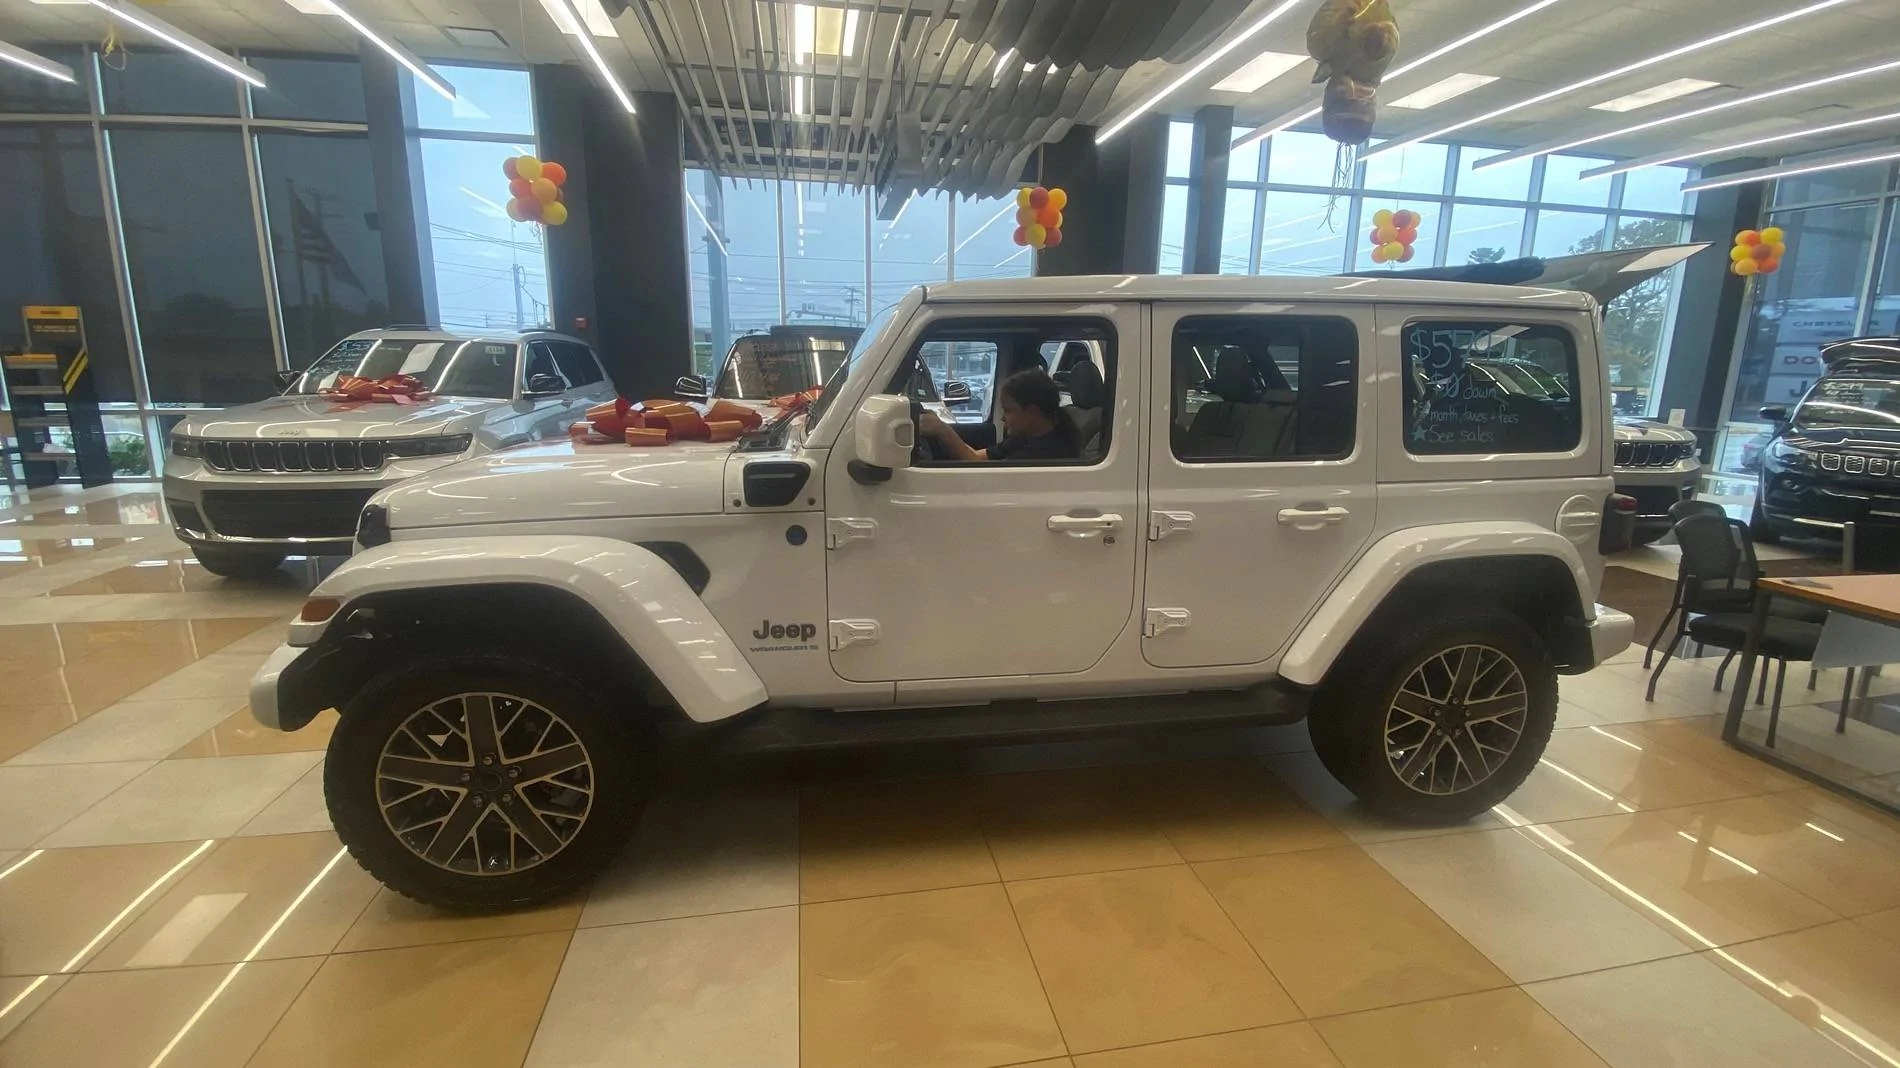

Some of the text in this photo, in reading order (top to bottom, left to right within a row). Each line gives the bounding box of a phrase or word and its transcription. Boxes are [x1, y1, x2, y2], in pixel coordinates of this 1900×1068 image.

[1462, 374, 1497, 400] down
[1429, 424, 1495, 443] See sales
[752, 619, 817, 642] Jeep
